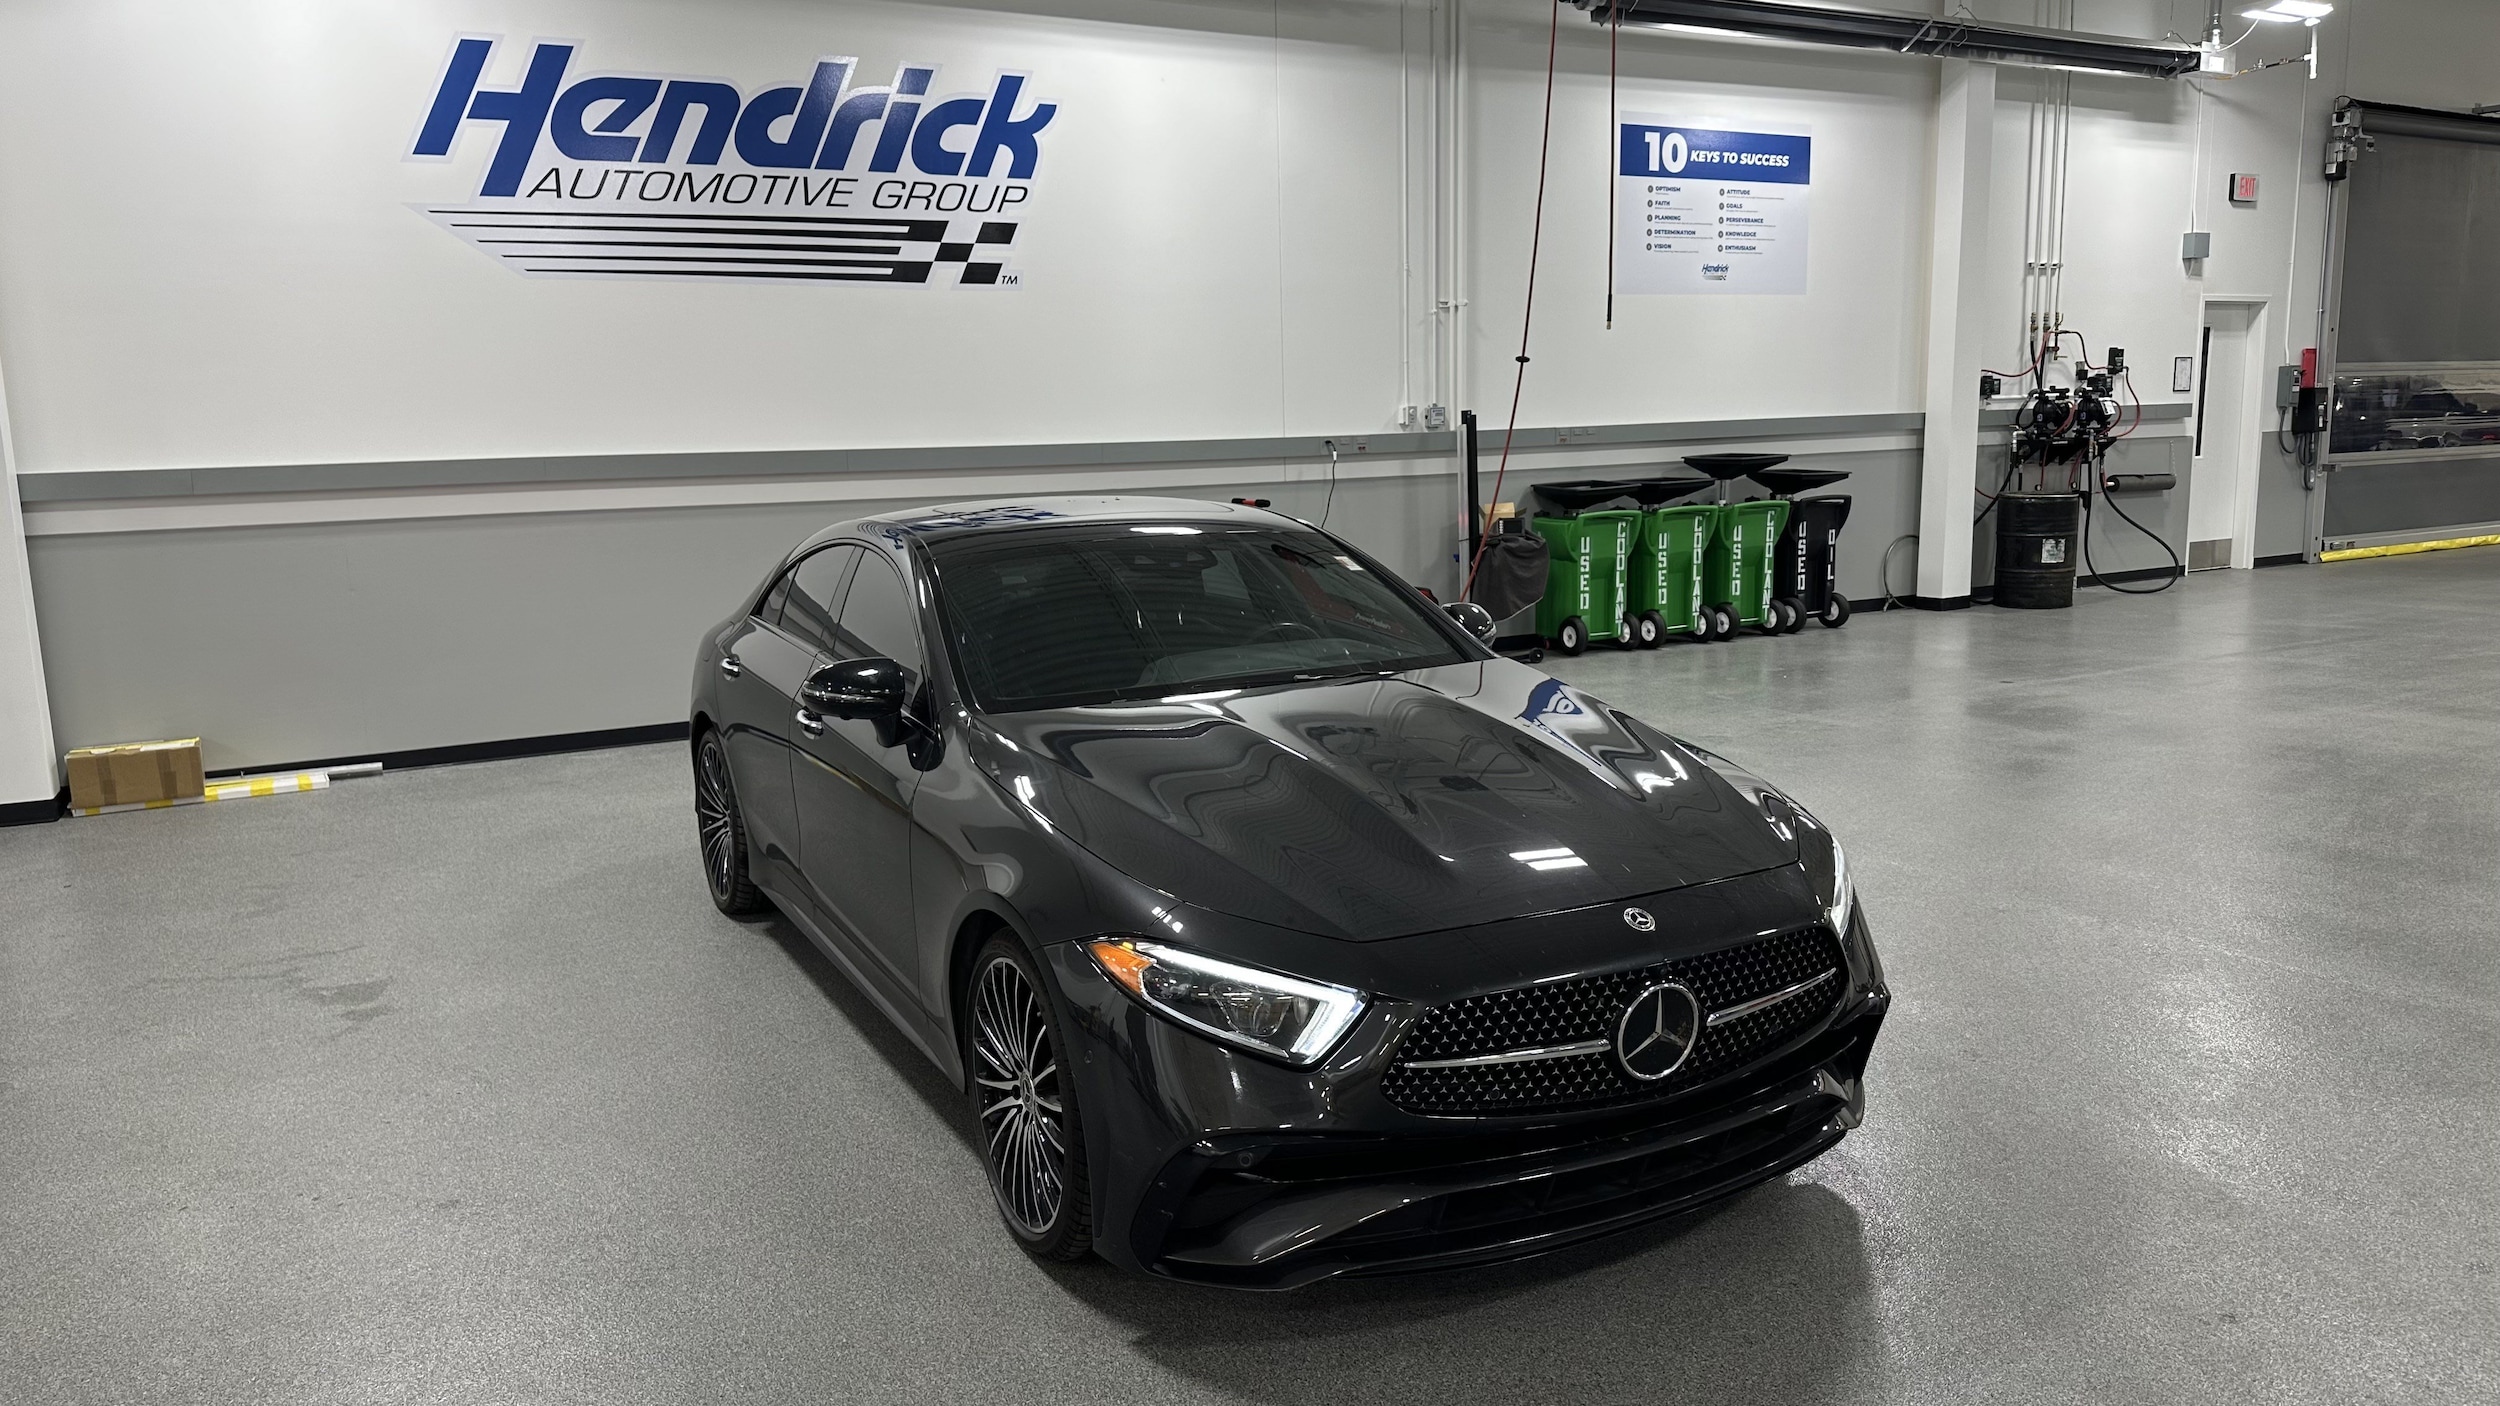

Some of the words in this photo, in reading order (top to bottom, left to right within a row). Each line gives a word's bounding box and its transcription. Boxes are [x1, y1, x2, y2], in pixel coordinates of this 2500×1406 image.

[412, 39, 1057, 198] Hendrick
[1644, 131, 1688, 173] 10
[1690, 149, 1720, 163] KEYS
[1722, 151, 1738, 164] TO
[1739, 153, 1790, 167] SUCCESS
[526, 167, 859, 208] AUTOMOTIVE
[872, 180, 1029, 213] GROUP
[2239, 176, 2257, 198] EXIT
[1002, 275, 1018, 285] TM
[1701, 263, 1730, 275] Hendrick
[1580, 536, 1590, 610] USED
[1615, 521, 1627, 636] COOLANT
[1658, 532, 1667, 605] USED
[1692, 515, 1703, 630] COOLANT
[1731, 525, 1742, 596] USED
[1762, 510, 1775, 621] COOLANT
[1797, 521, 1807, 591] USED
[1827, 529, 1836, 580] OIL
